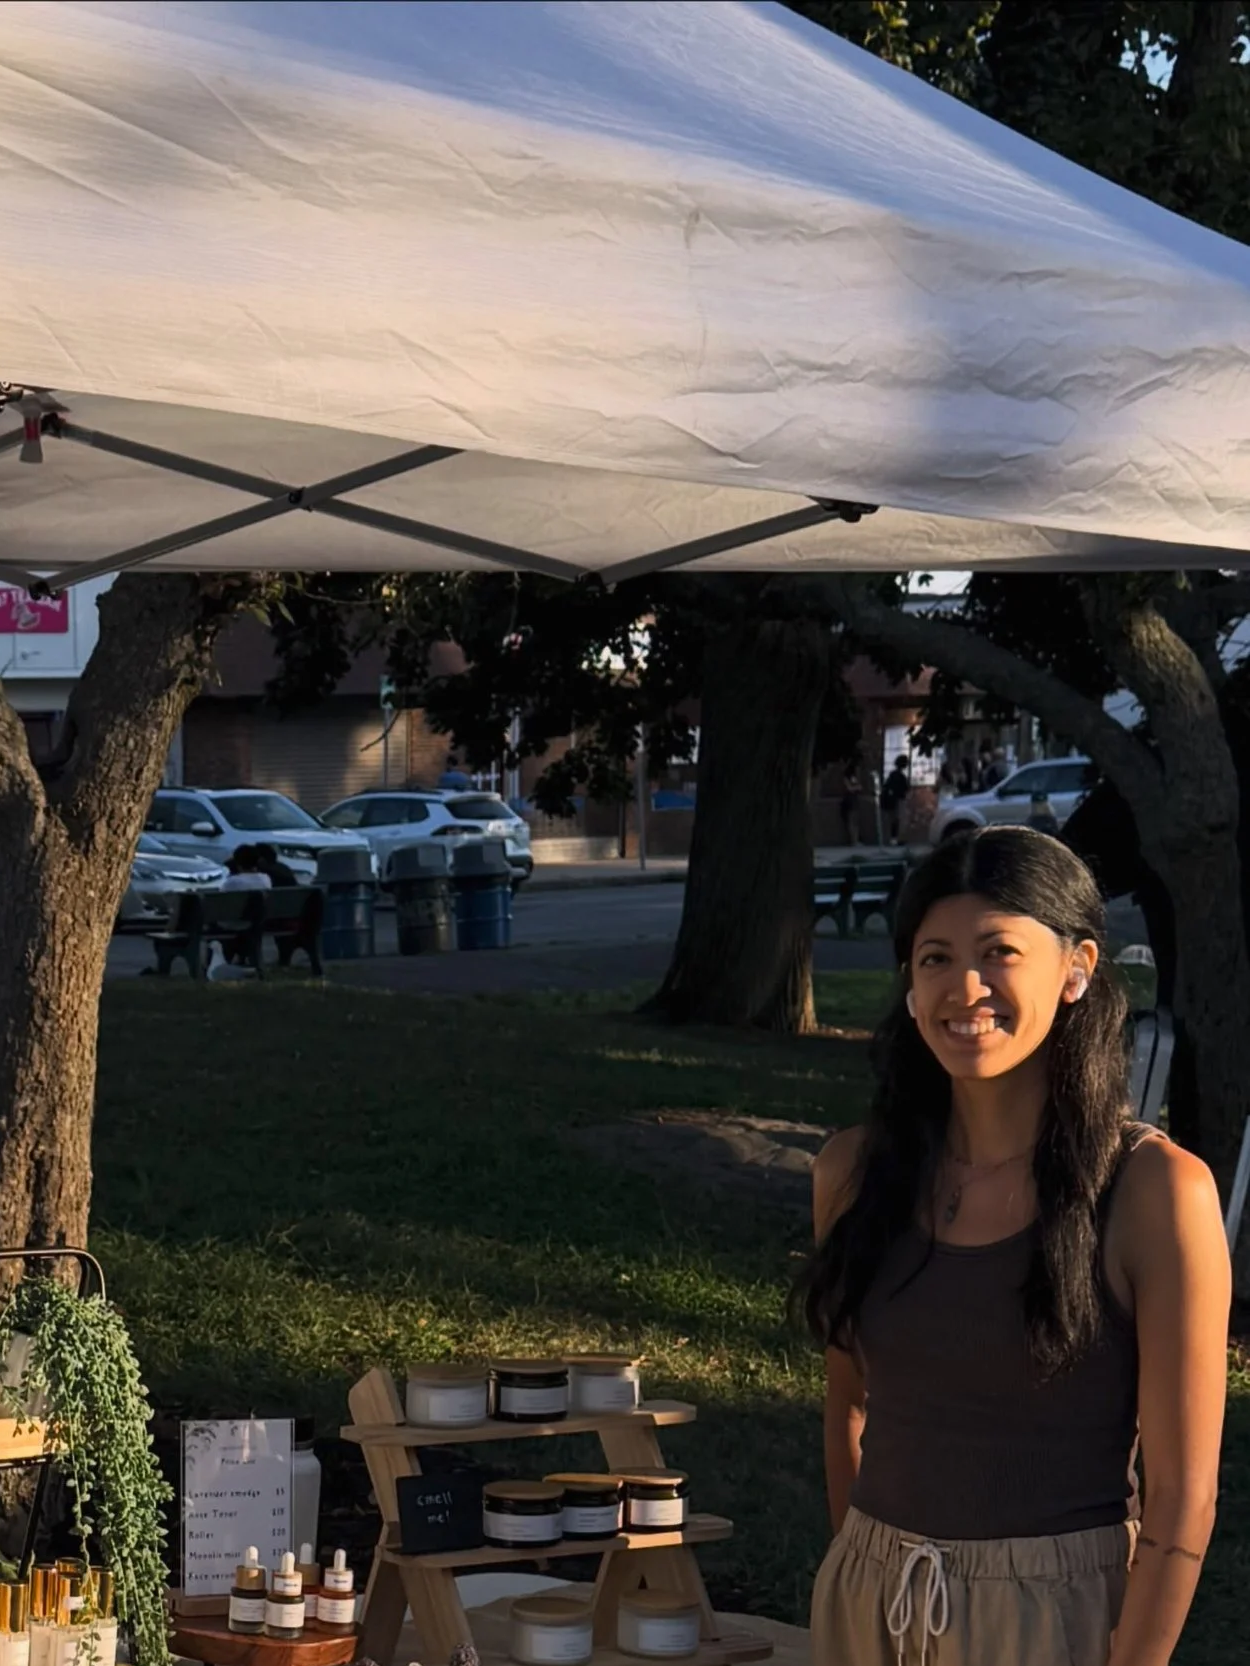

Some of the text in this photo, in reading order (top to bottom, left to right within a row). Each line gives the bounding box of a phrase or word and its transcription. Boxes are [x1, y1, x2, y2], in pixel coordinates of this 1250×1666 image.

[188, 1490, 228, 1499] Lavender
[427, 1509, 450, 1523] me!
[188, 1531, 214, 1540] Roller
